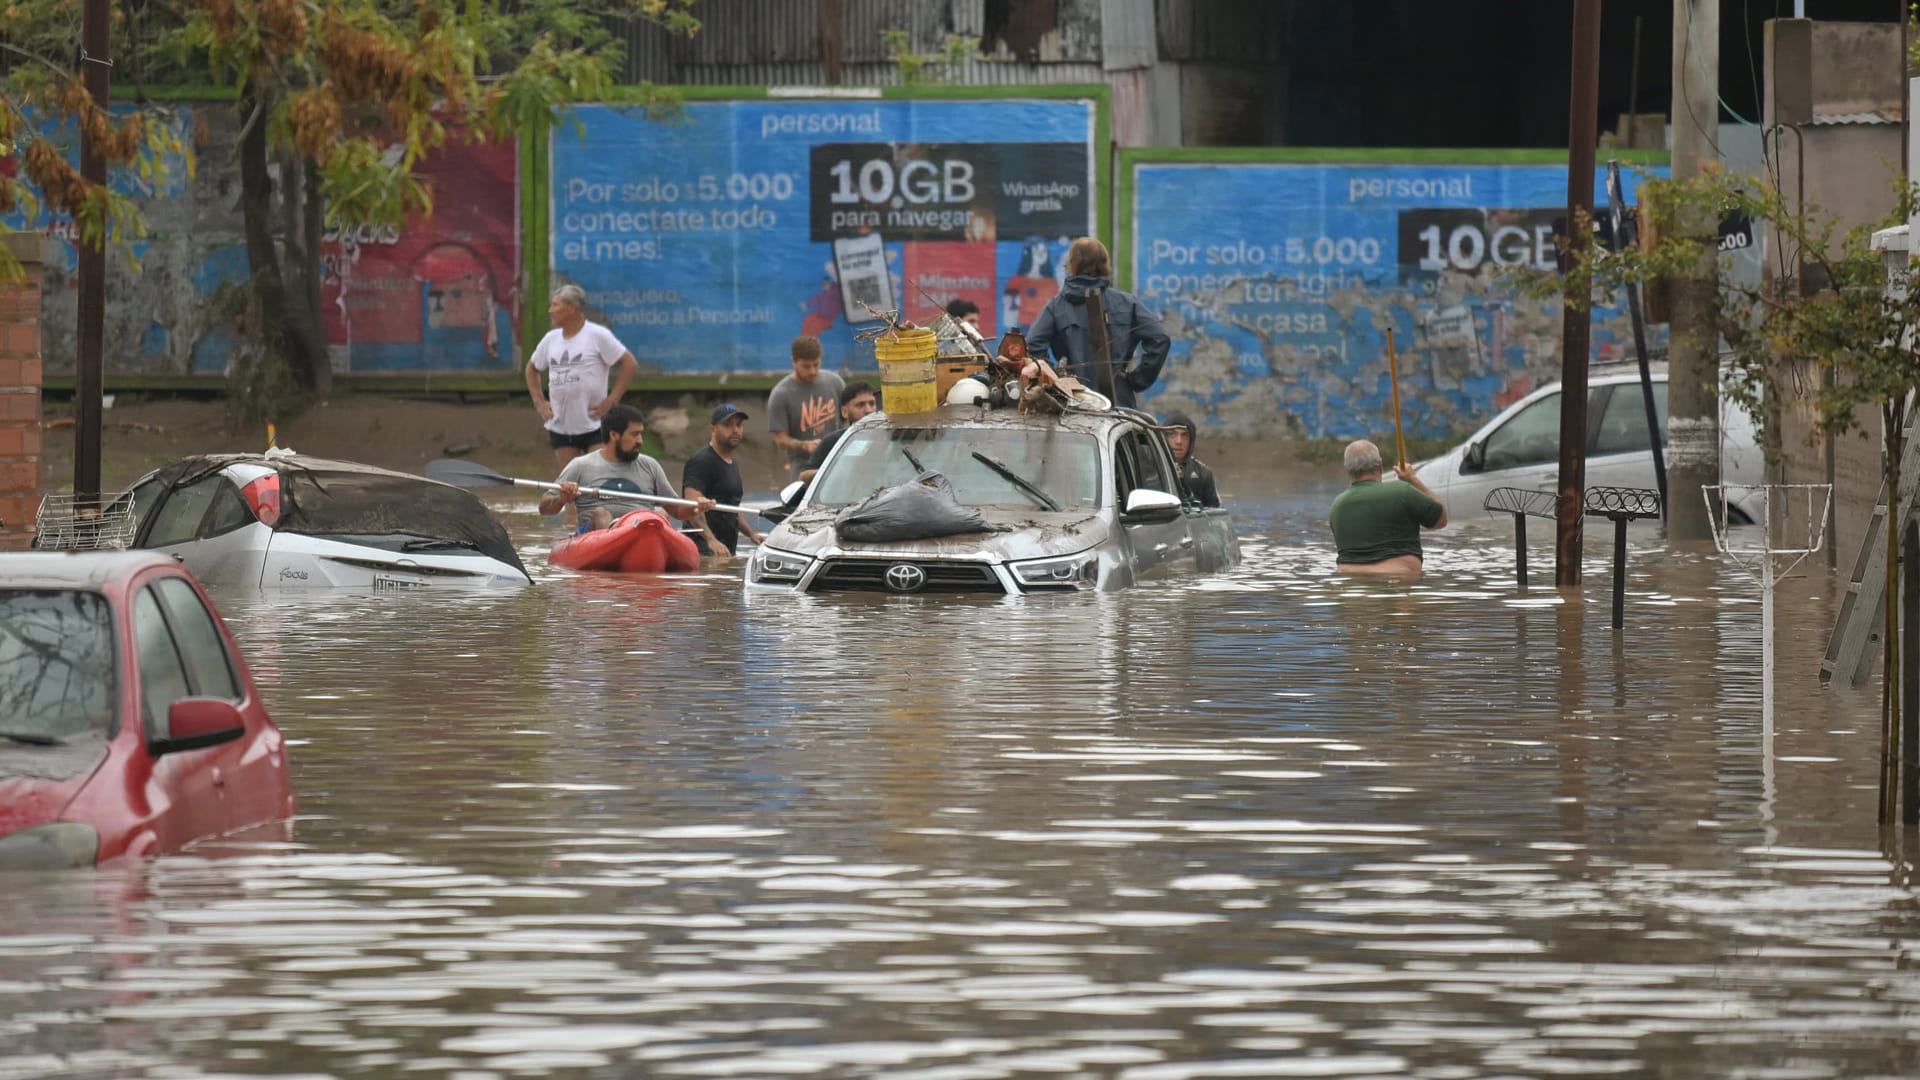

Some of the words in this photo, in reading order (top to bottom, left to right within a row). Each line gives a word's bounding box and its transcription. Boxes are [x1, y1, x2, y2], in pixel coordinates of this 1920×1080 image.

[761, 106, 881, 138] personal
[622, 176, 679, 202] solo
[1002, 181, 1080, 200] WhatsApp
[1350, 175, 1473, 202] personal
[563, 211, 705, 232] conectate
[711, 204, 776, 229] todo
[1020, 198, 1063, 214] gratis
[831, 209, 881, 230] para
[887, 209, 974, 230] navegar
[563, 236, 590, 260] el
[1205, 239, 1266, 265] solo
[1255, 311, 1329, 334] casa
